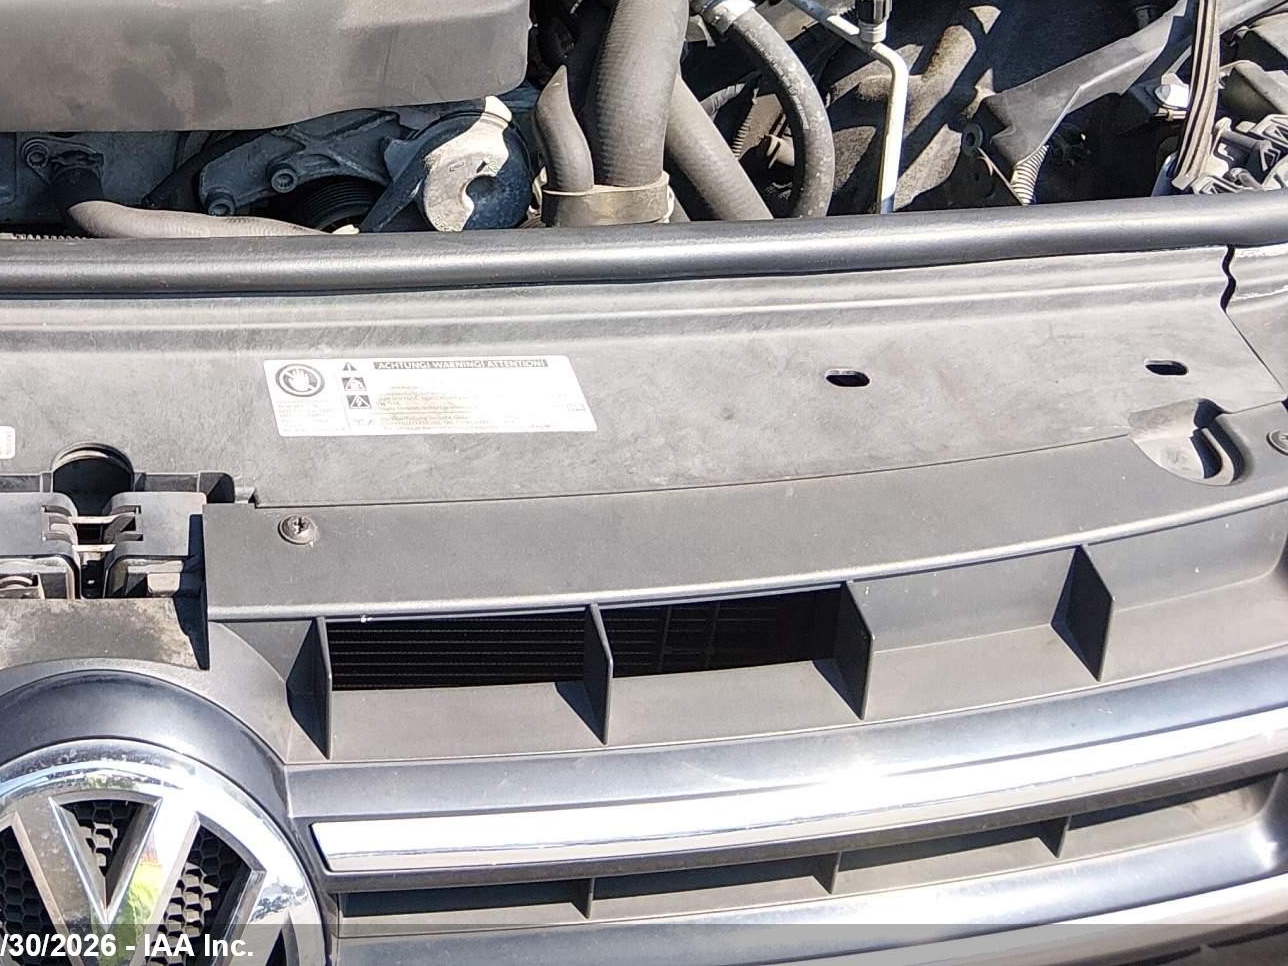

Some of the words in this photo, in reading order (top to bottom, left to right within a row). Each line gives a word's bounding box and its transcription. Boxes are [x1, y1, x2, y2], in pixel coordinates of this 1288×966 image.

[378, 362, 430, 370] ACHTUNG!
[431, 361, 485, 369] WARNING!
[489, 360, 546, 368] ATTENTION!
